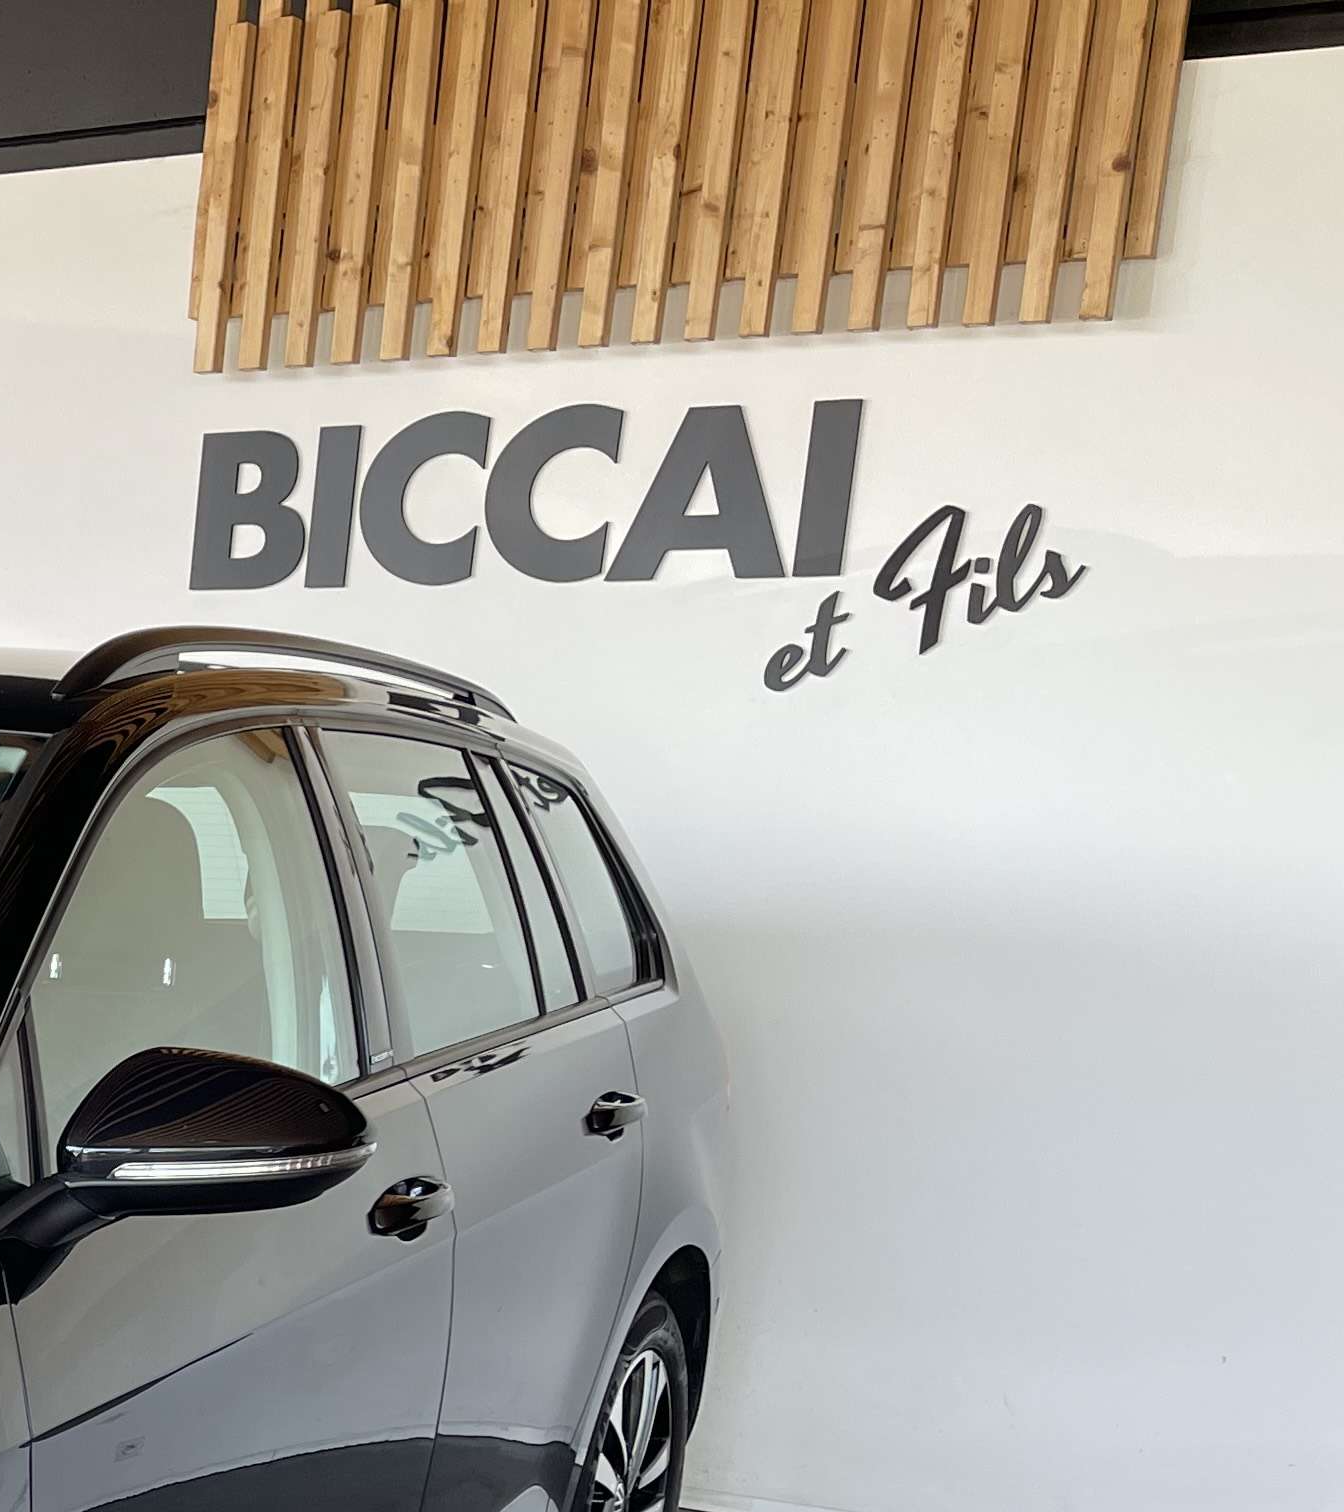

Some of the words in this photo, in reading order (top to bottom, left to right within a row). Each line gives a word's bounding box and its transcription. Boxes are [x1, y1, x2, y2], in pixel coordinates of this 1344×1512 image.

[190, 399, 864, 591] BICCAI
[763, 591, 853, 692] et
[872, 502, 1089, 655] Fils
